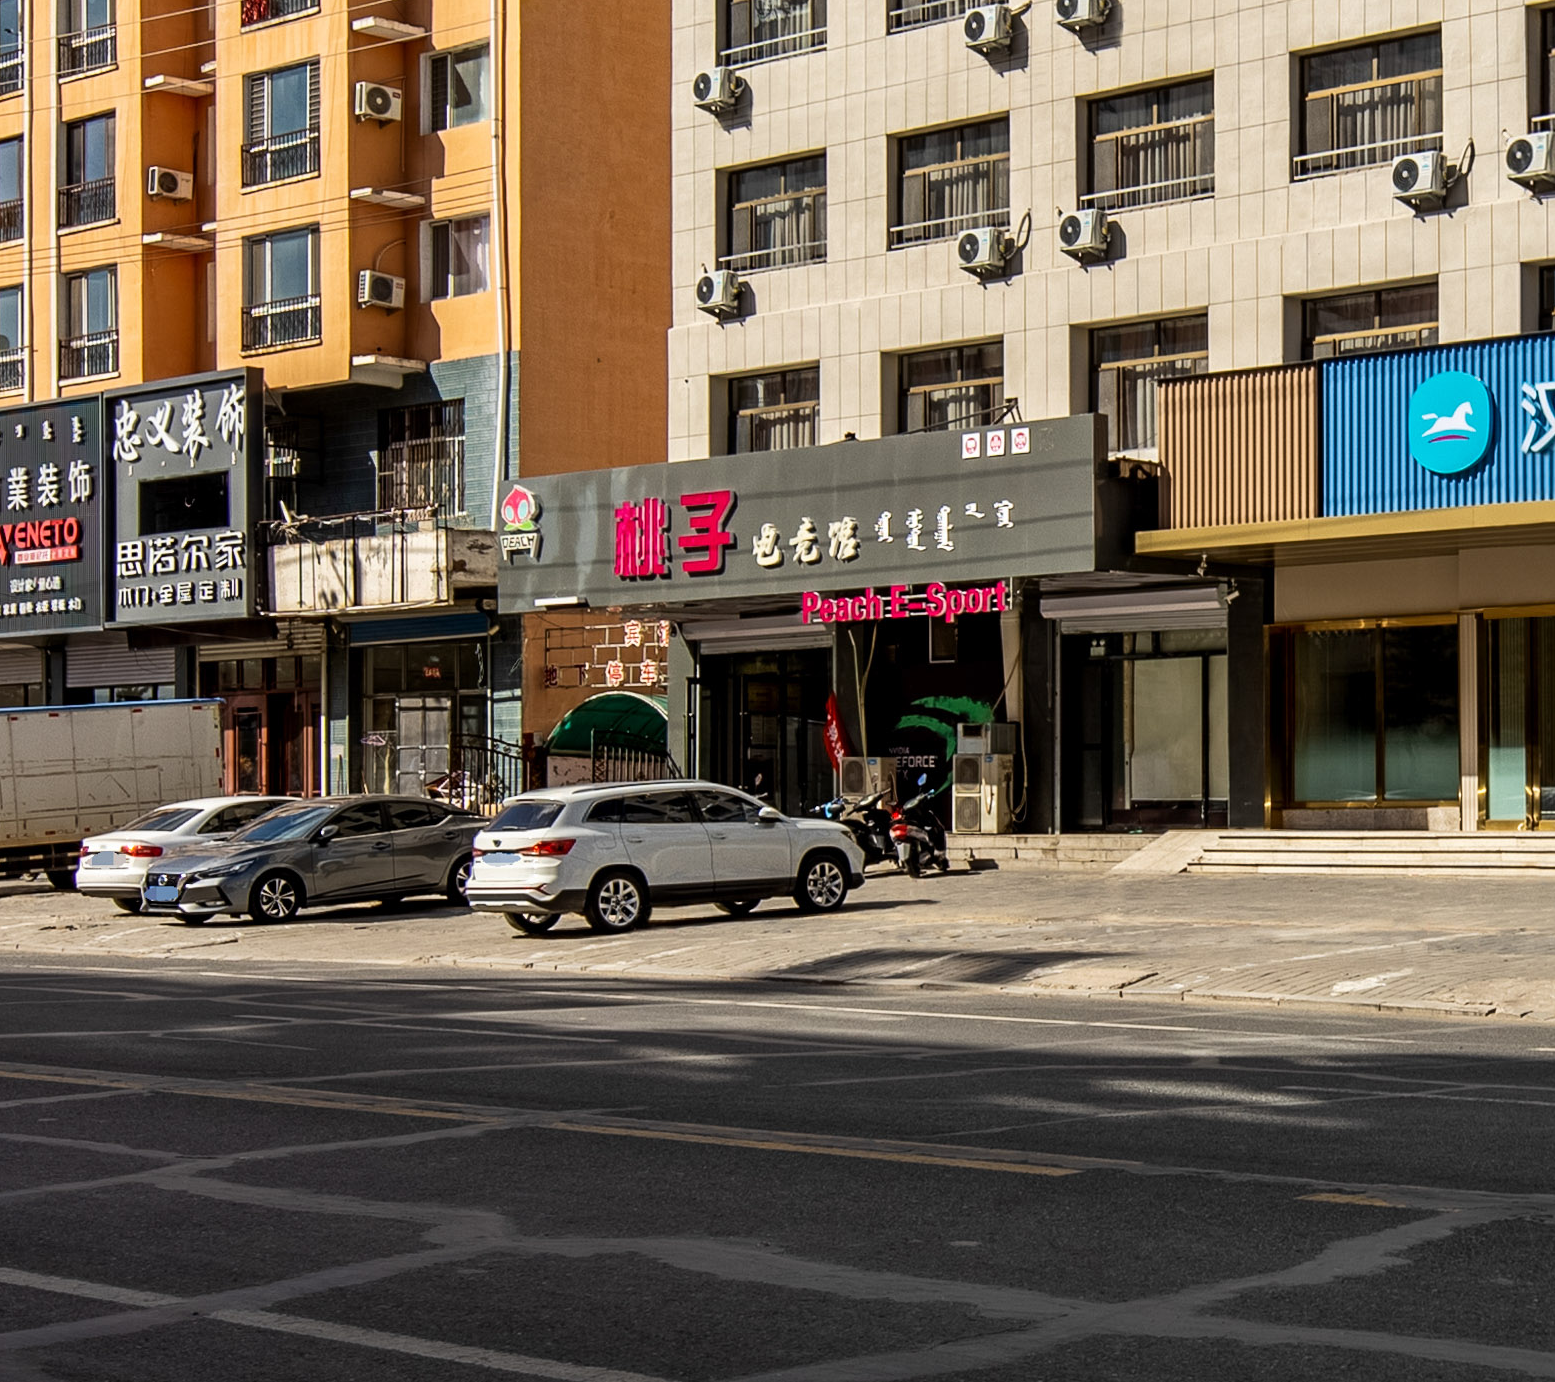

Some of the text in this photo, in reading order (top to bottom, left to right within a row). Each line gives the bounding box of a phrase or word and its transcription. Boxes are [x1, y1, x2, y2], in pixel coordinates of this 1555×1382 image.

[113, 383, 246, 461] 忠义装饰
[116, 531, 245, 576] 思诺尔家
[502, 535, 535, 551] PEACH
[614, 490, 736, 577] 桃子
[802, 580, 1008, 624] Peach E-Sport
[896, 755, 936, 768] EFORCE
